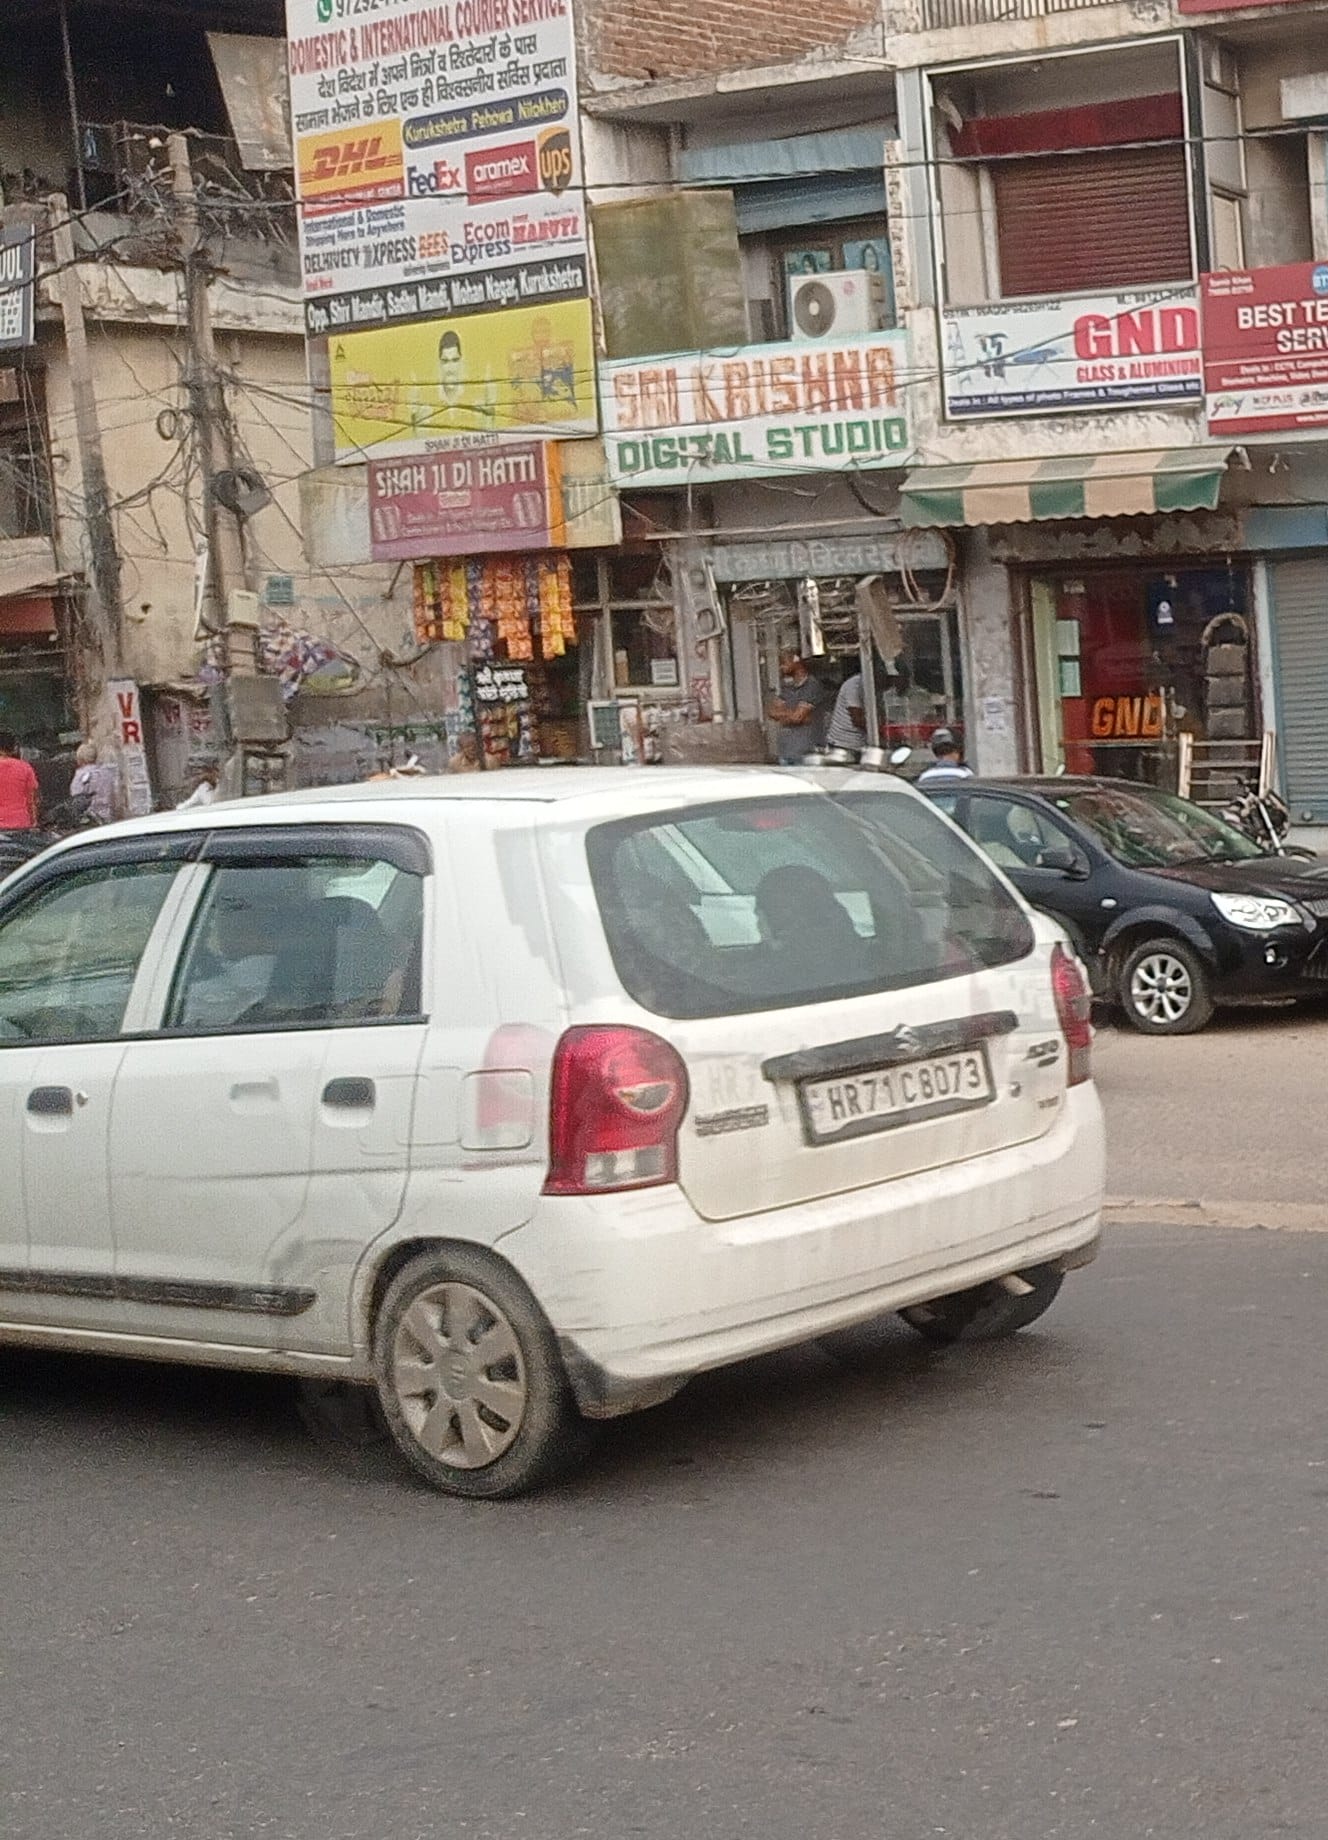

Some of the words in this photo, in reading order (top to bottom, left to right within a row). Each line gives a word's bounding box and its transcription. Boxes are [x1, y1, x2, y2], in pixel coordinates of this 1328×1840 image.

[290, 34, 346, 76] DOMESTIC
[360, 14, 451, 59] INTERNATIONAL
[455, 1, 510, 40] COURIER
[405, 114, 467, 141] Kurukshetra
[313, 137, 386, 179] DHL
[473, 155, 530, 183] aramex
[541, 147, 572, 179] ups
[407, 160, 461, 195] FedEx
[463, 219, 510, 243] Ecom
[451, 239, 511, 264] Express
[1073, 307, 1199, 361] GND
[1237, 303, 1298, 330] BEST
[695, 347, 897, 423] KRISHNA
[1077, 364, 1115, 384] GLASS
[1129, 358, 1200, 379] ALUMINIUM
[617, 431, 755, 474] DIGITAL
[766, 416, 909, 460] STUDIO
[376, 465, 427, 499] SHAH
[432, 463, 446, 493] JI
[453, 459, 473, 489] DI
[478, 452, 537, 486] HATTI
[1092, 694, 1163, 736] GND
